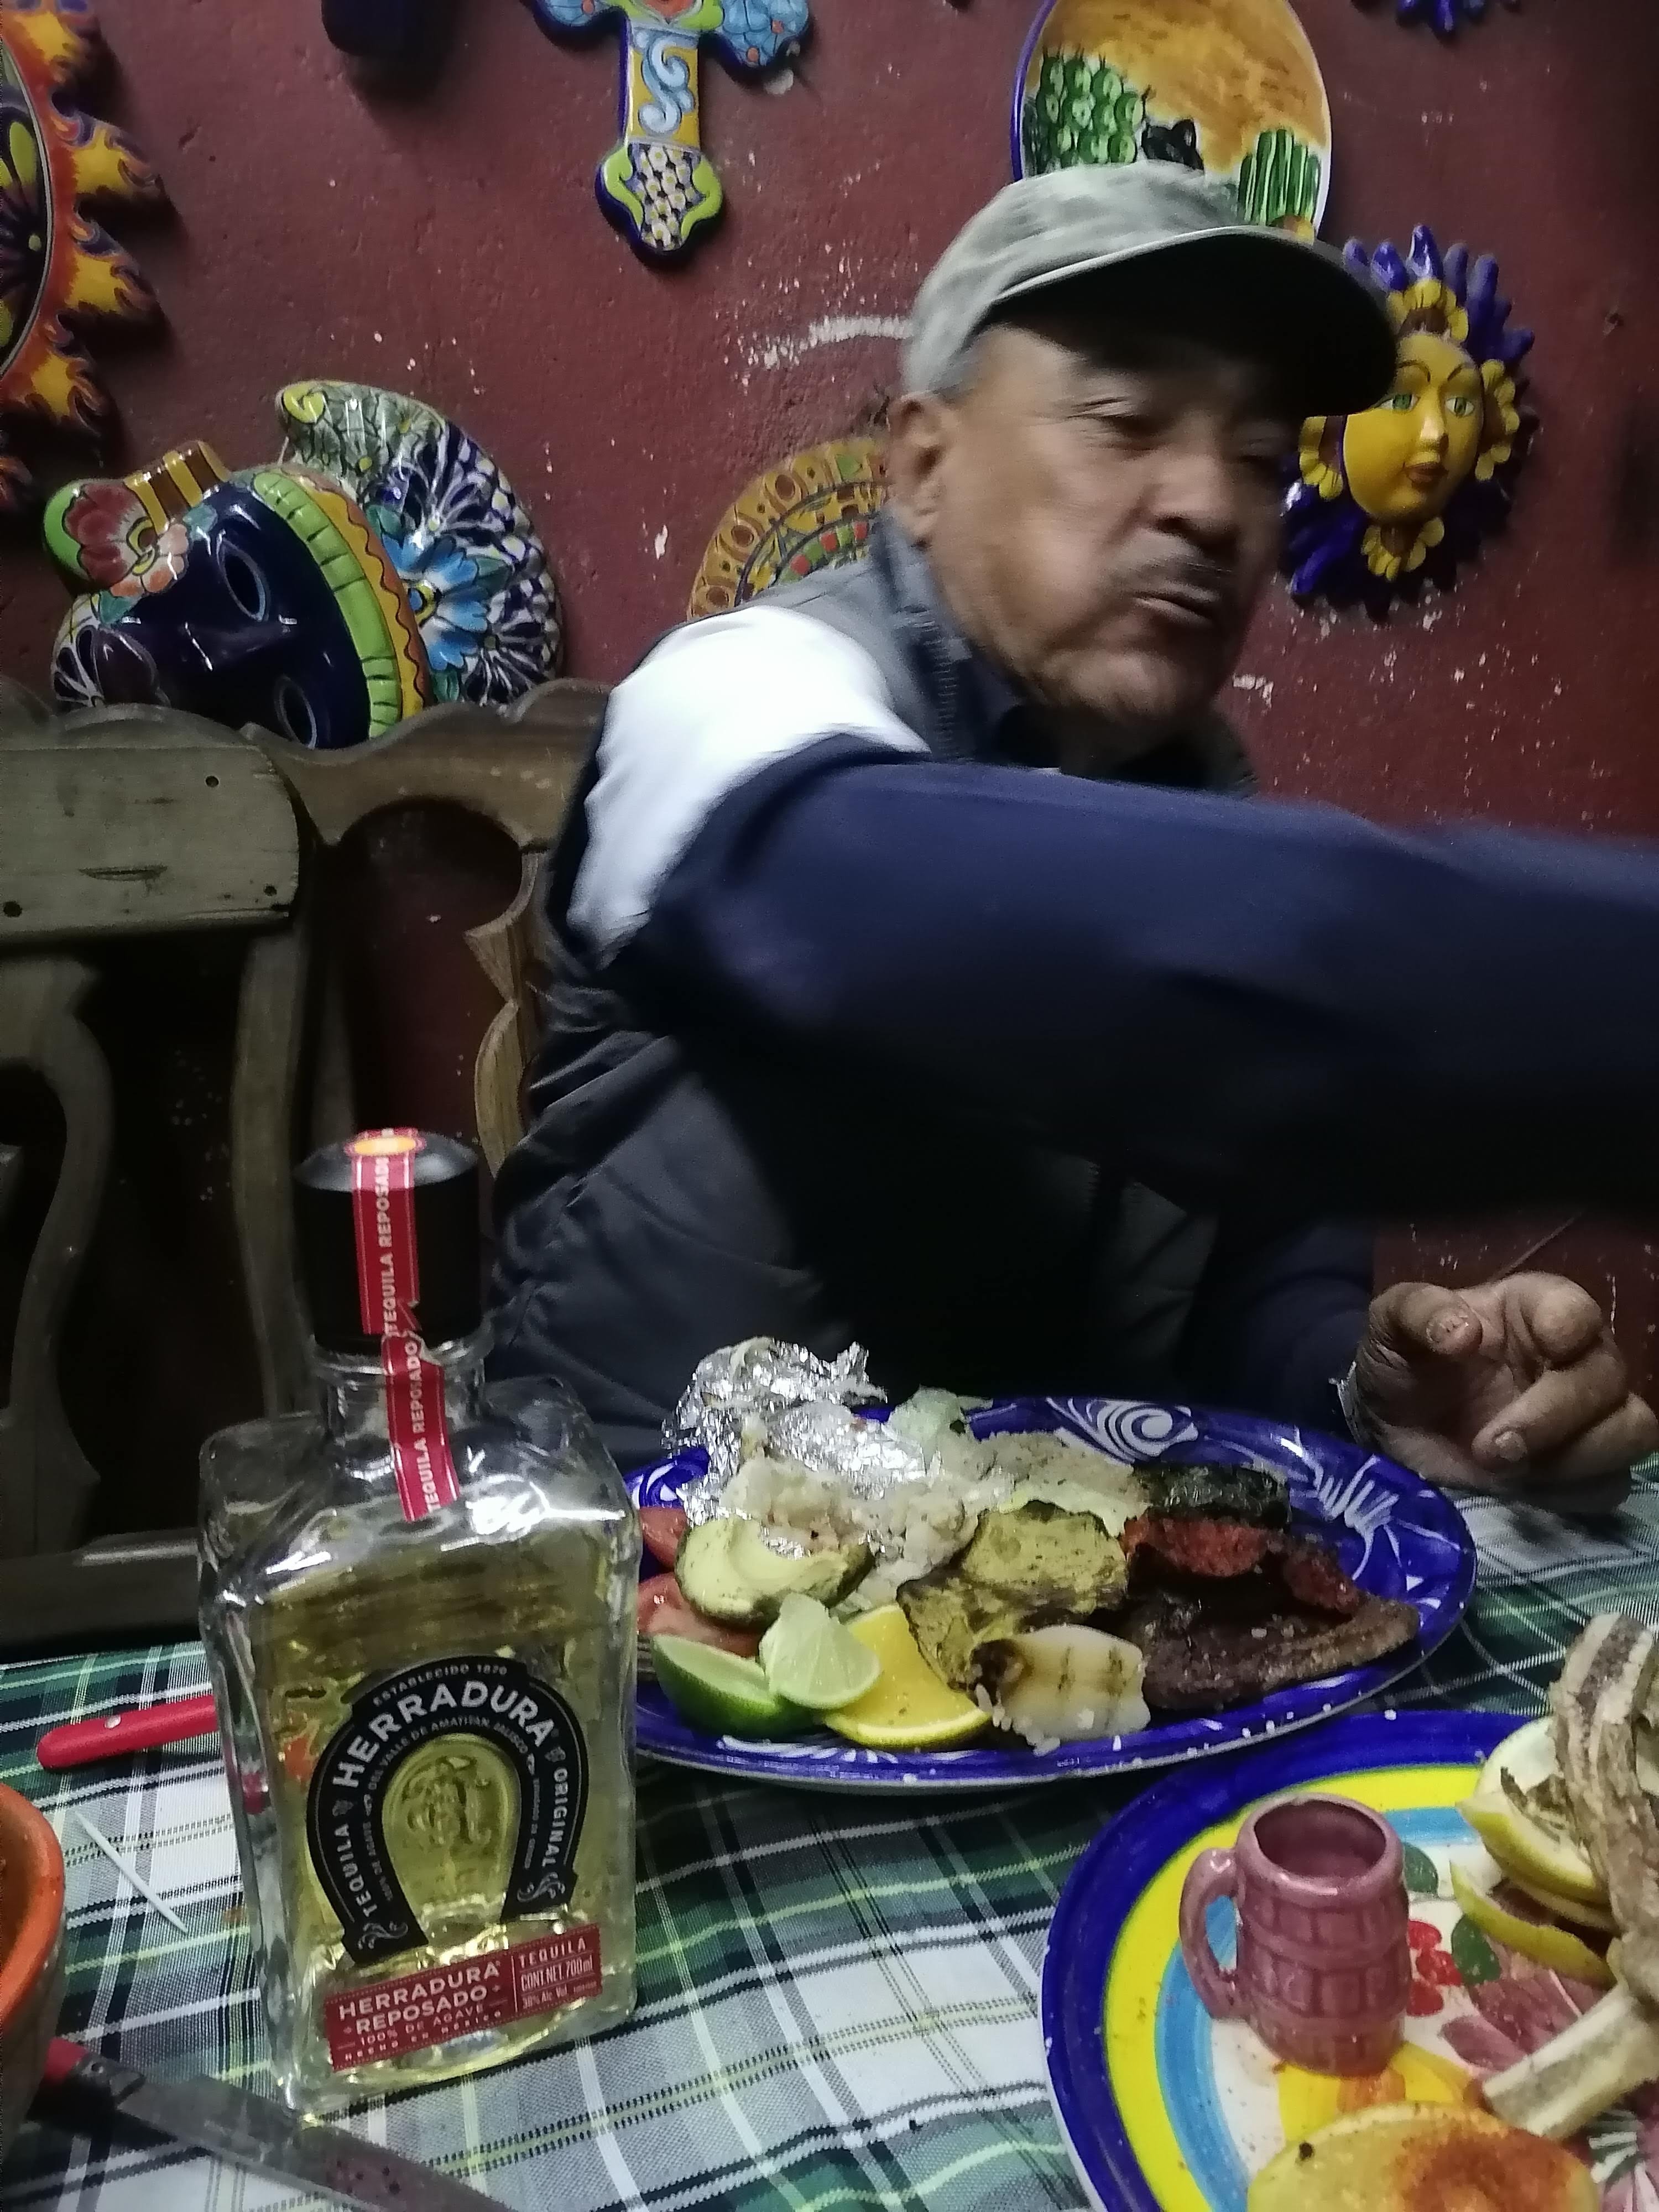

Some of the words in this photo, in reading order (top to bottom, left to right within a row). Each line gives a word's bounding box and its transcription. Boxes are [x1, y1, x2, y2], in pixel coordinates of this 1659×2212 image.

[380, 1252, 398, 1335] TEQUILA
[404, 1340, 425, 1433] REPOSADO
[414, 1437, 441, 1512] TEQUILA
[333, 1680, 554, 1788] HERRADURA
[542, 1767, 568, 1867] ORIGINAL
[335, 1824, 378, 1917] TEQUILA
[338, 1961, 500, 2020] HERRADURA
[519, 1937, 586, 1969] TEQUILA
[356, 1985, 487, 2034] REPOSADO
[361, 2027, 398, 2046] 100%
[405, 2020, 425, 2034] DE
[433, 2004, 484, 2028] AGAVE
